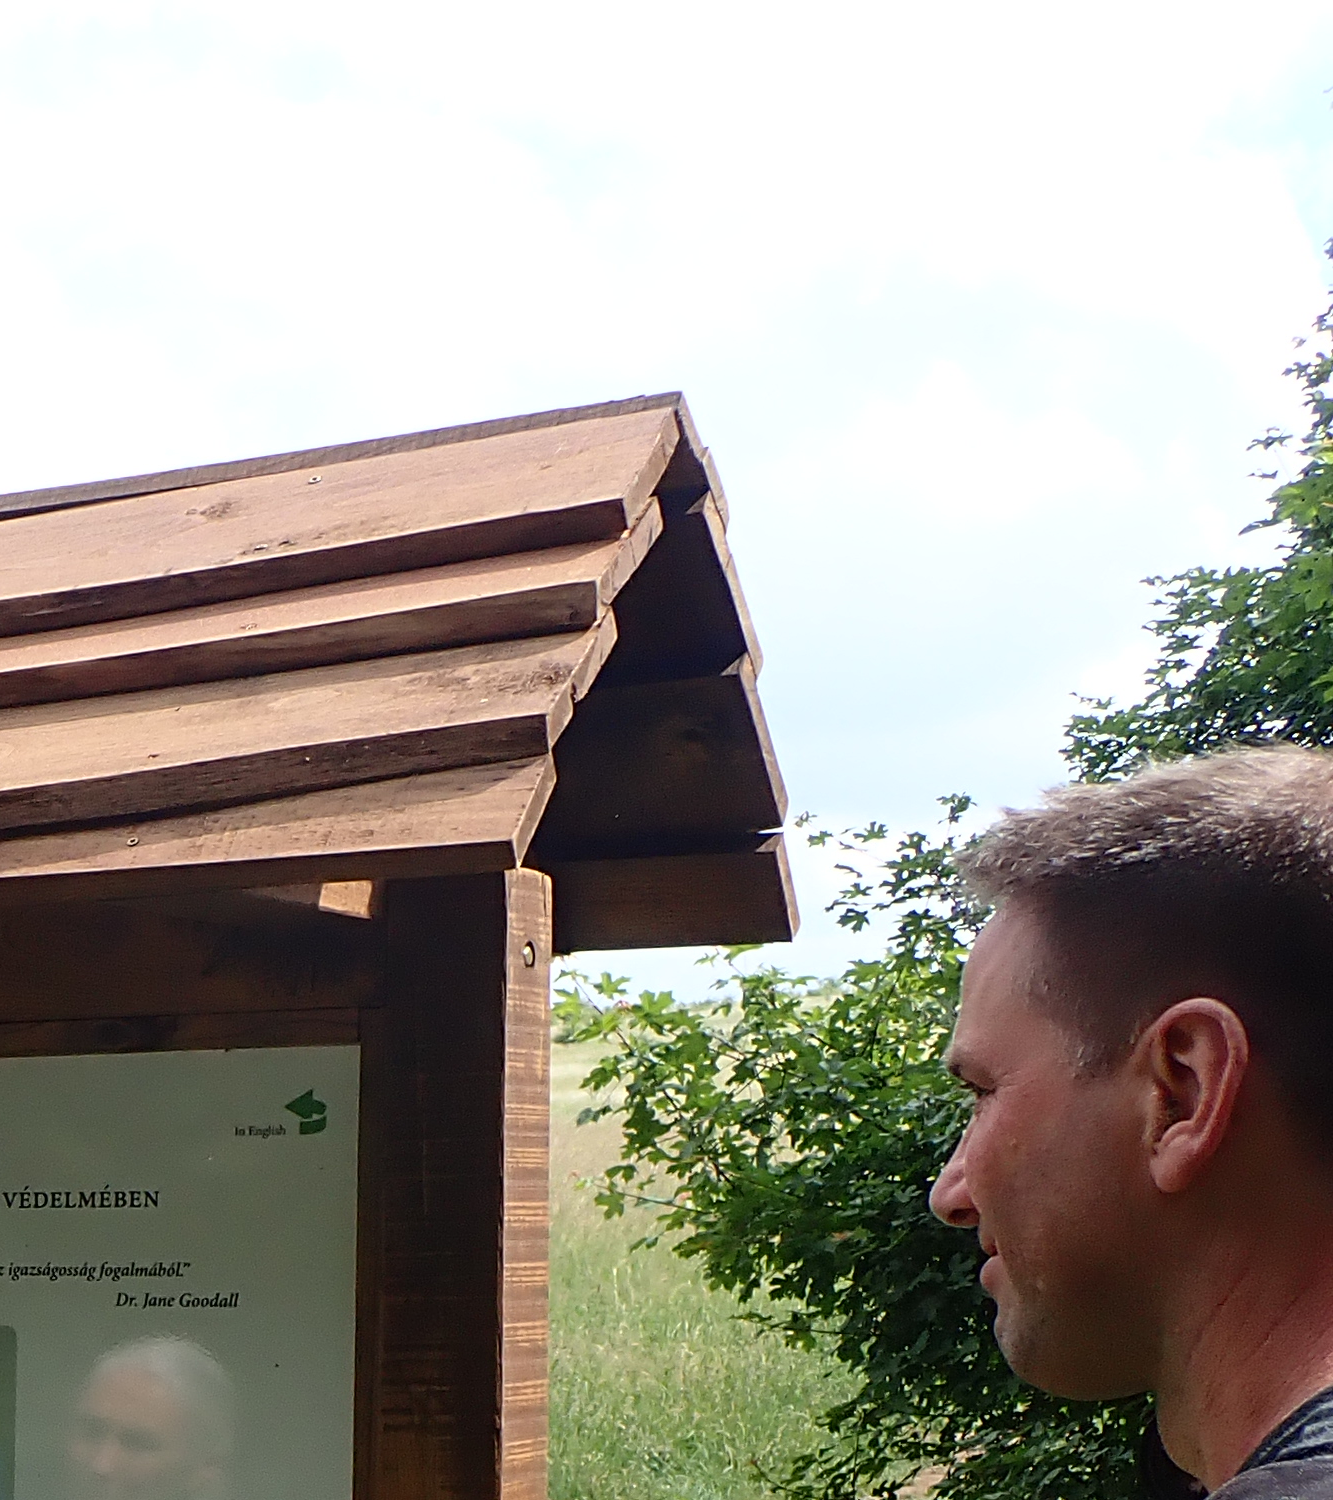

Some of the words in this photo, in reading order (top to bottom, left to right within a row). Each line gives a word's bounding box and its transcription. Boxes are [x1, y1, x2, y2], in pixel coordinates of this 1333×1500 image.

[249, 1125, 286, 1139] English
[2, 1185, 159, 1208] VÉDELMÉBEN
[8, 1262, 96, 1281] igazságosság
[116, 1292, 137, 1307] Dr.
[142, 1293, 175, 1309] Jane
[179, 1293, 239, 1308] Goodall
